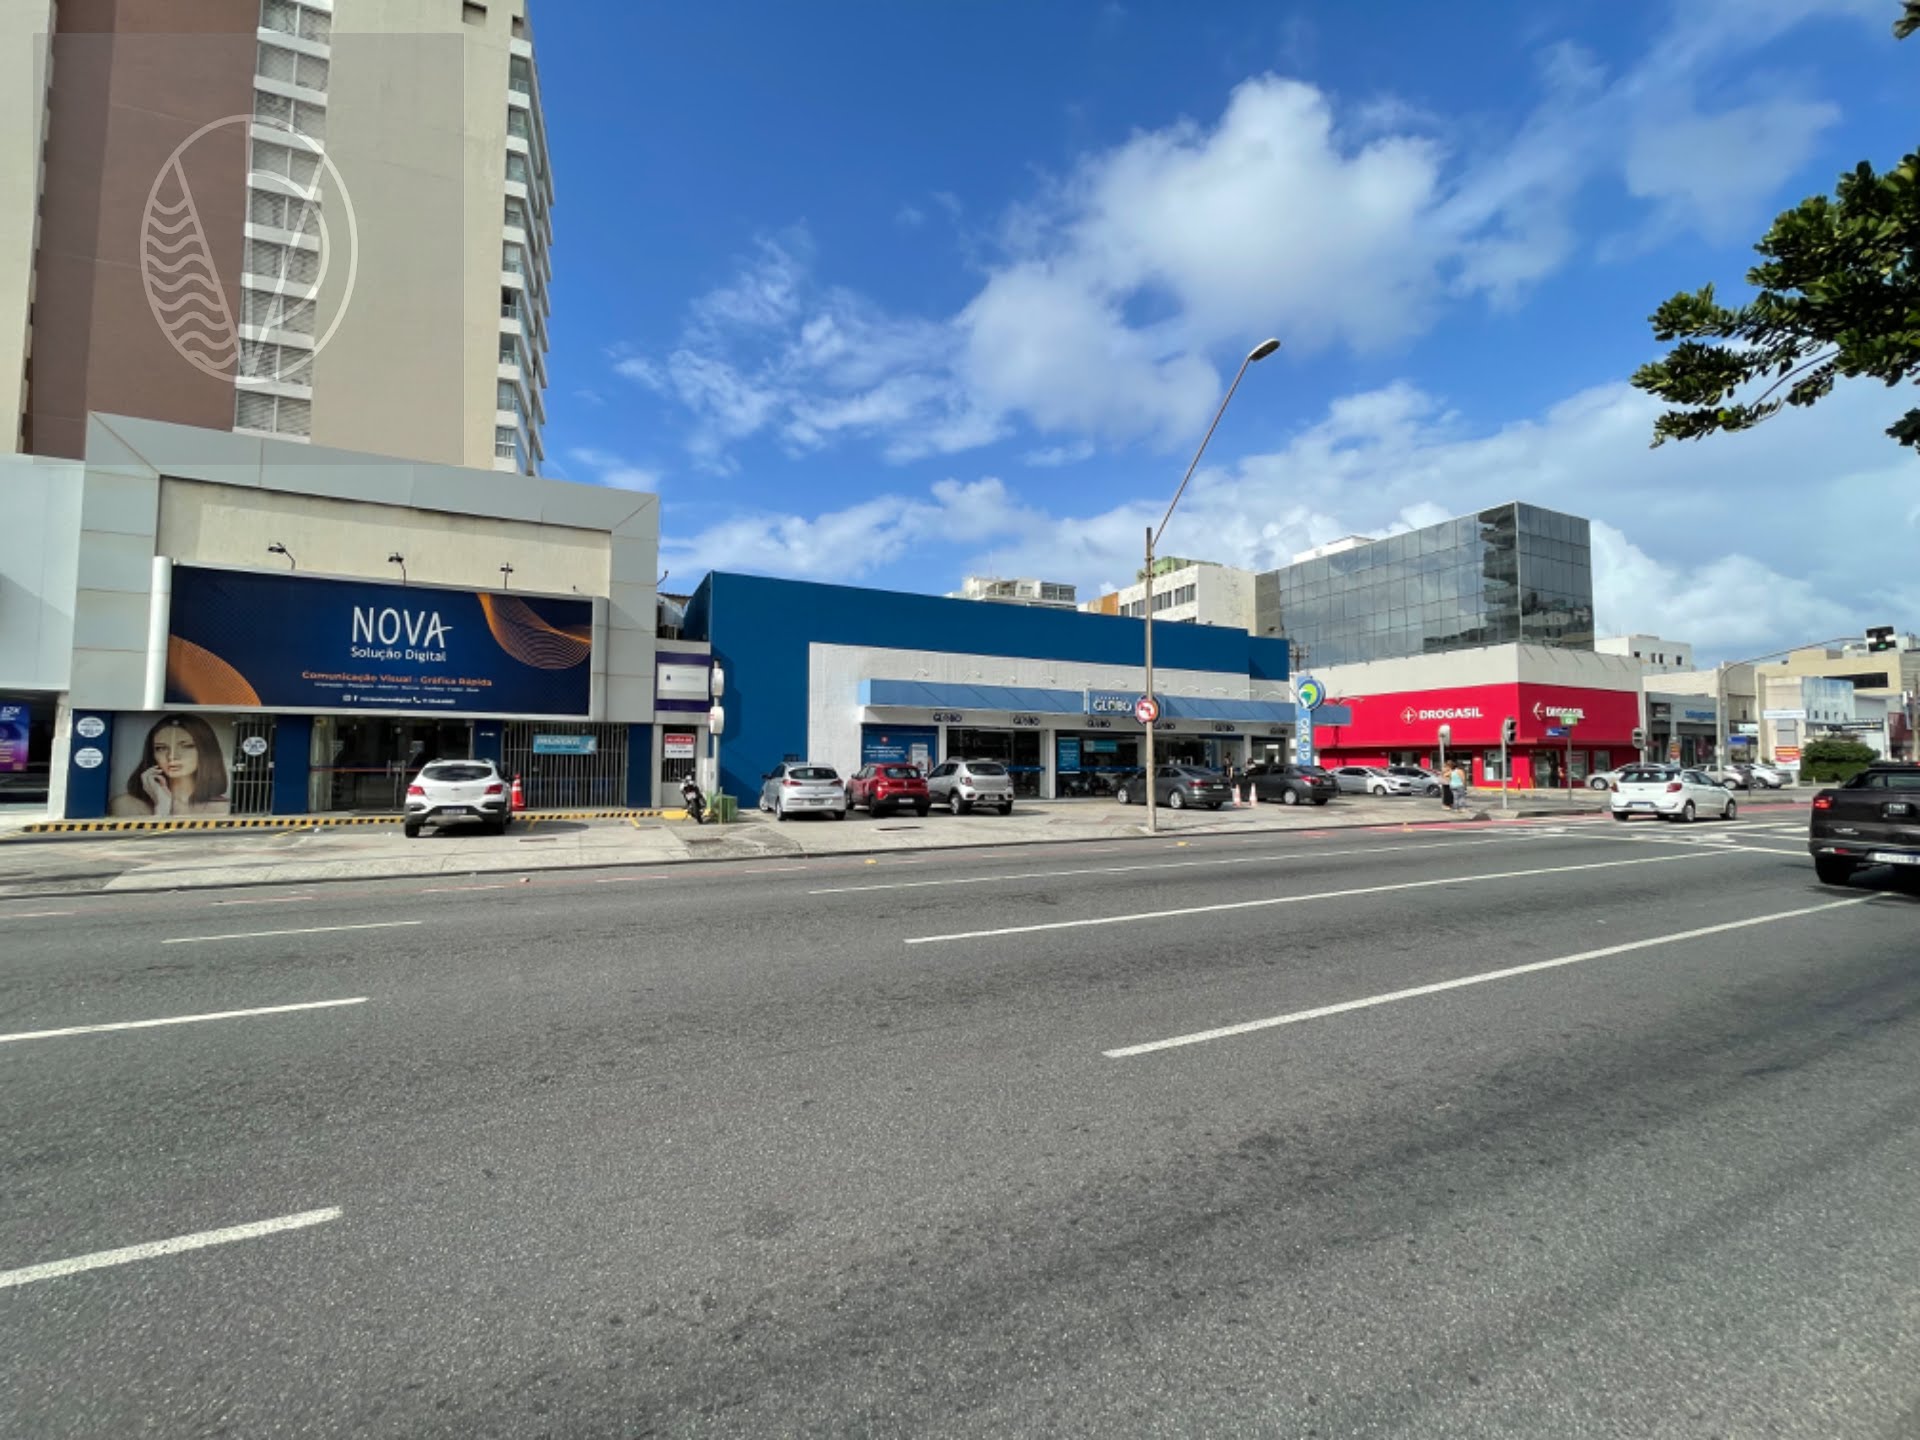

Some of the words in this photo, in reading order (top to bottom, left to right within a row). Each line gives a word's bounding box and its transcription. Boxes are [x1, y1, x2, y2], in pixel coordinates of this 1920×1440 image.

[352, 606, 453, 648] NOVA
[351, 646, 402, 662] Solução
[405, 650, 447, 663] Digital
[302, 671, 377, 683] Comunicação
[380, 675, 412, 684] Visual
[1419, 707, 1484, 719] DROGASIL
